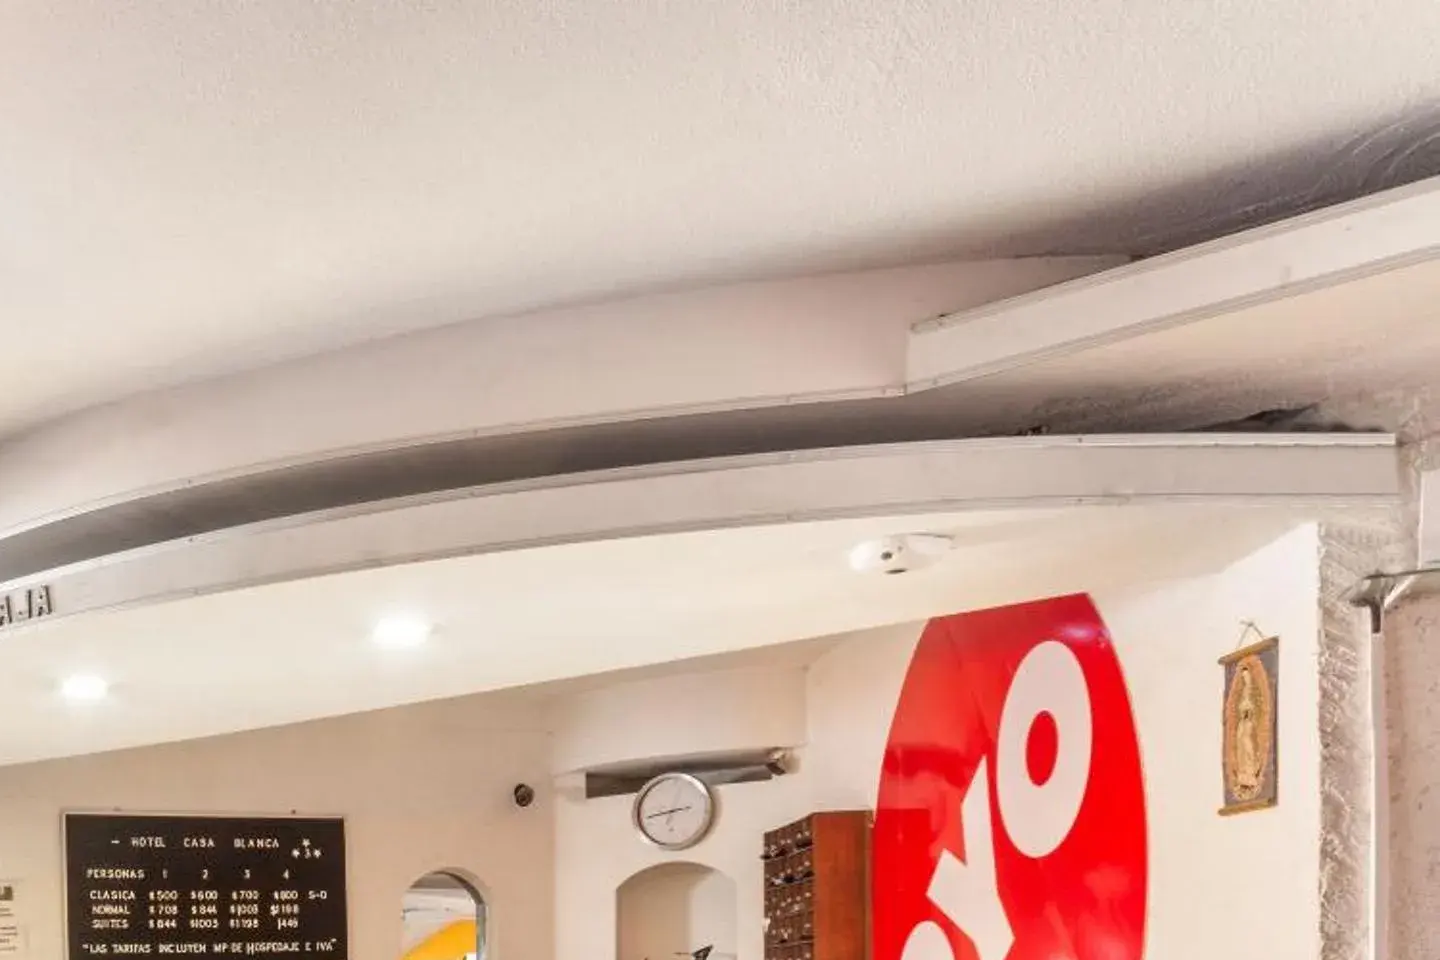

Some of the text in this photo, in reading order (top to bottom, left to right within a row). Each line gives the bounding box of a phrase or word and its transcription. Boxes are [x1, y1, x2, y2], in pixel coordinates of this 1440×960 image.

[131, 836, 280, 848] HOTEL CASA BLANCA
[86, 868, 145, 879] PERSONAS
[89, 889, 136, 901] CLASICA
